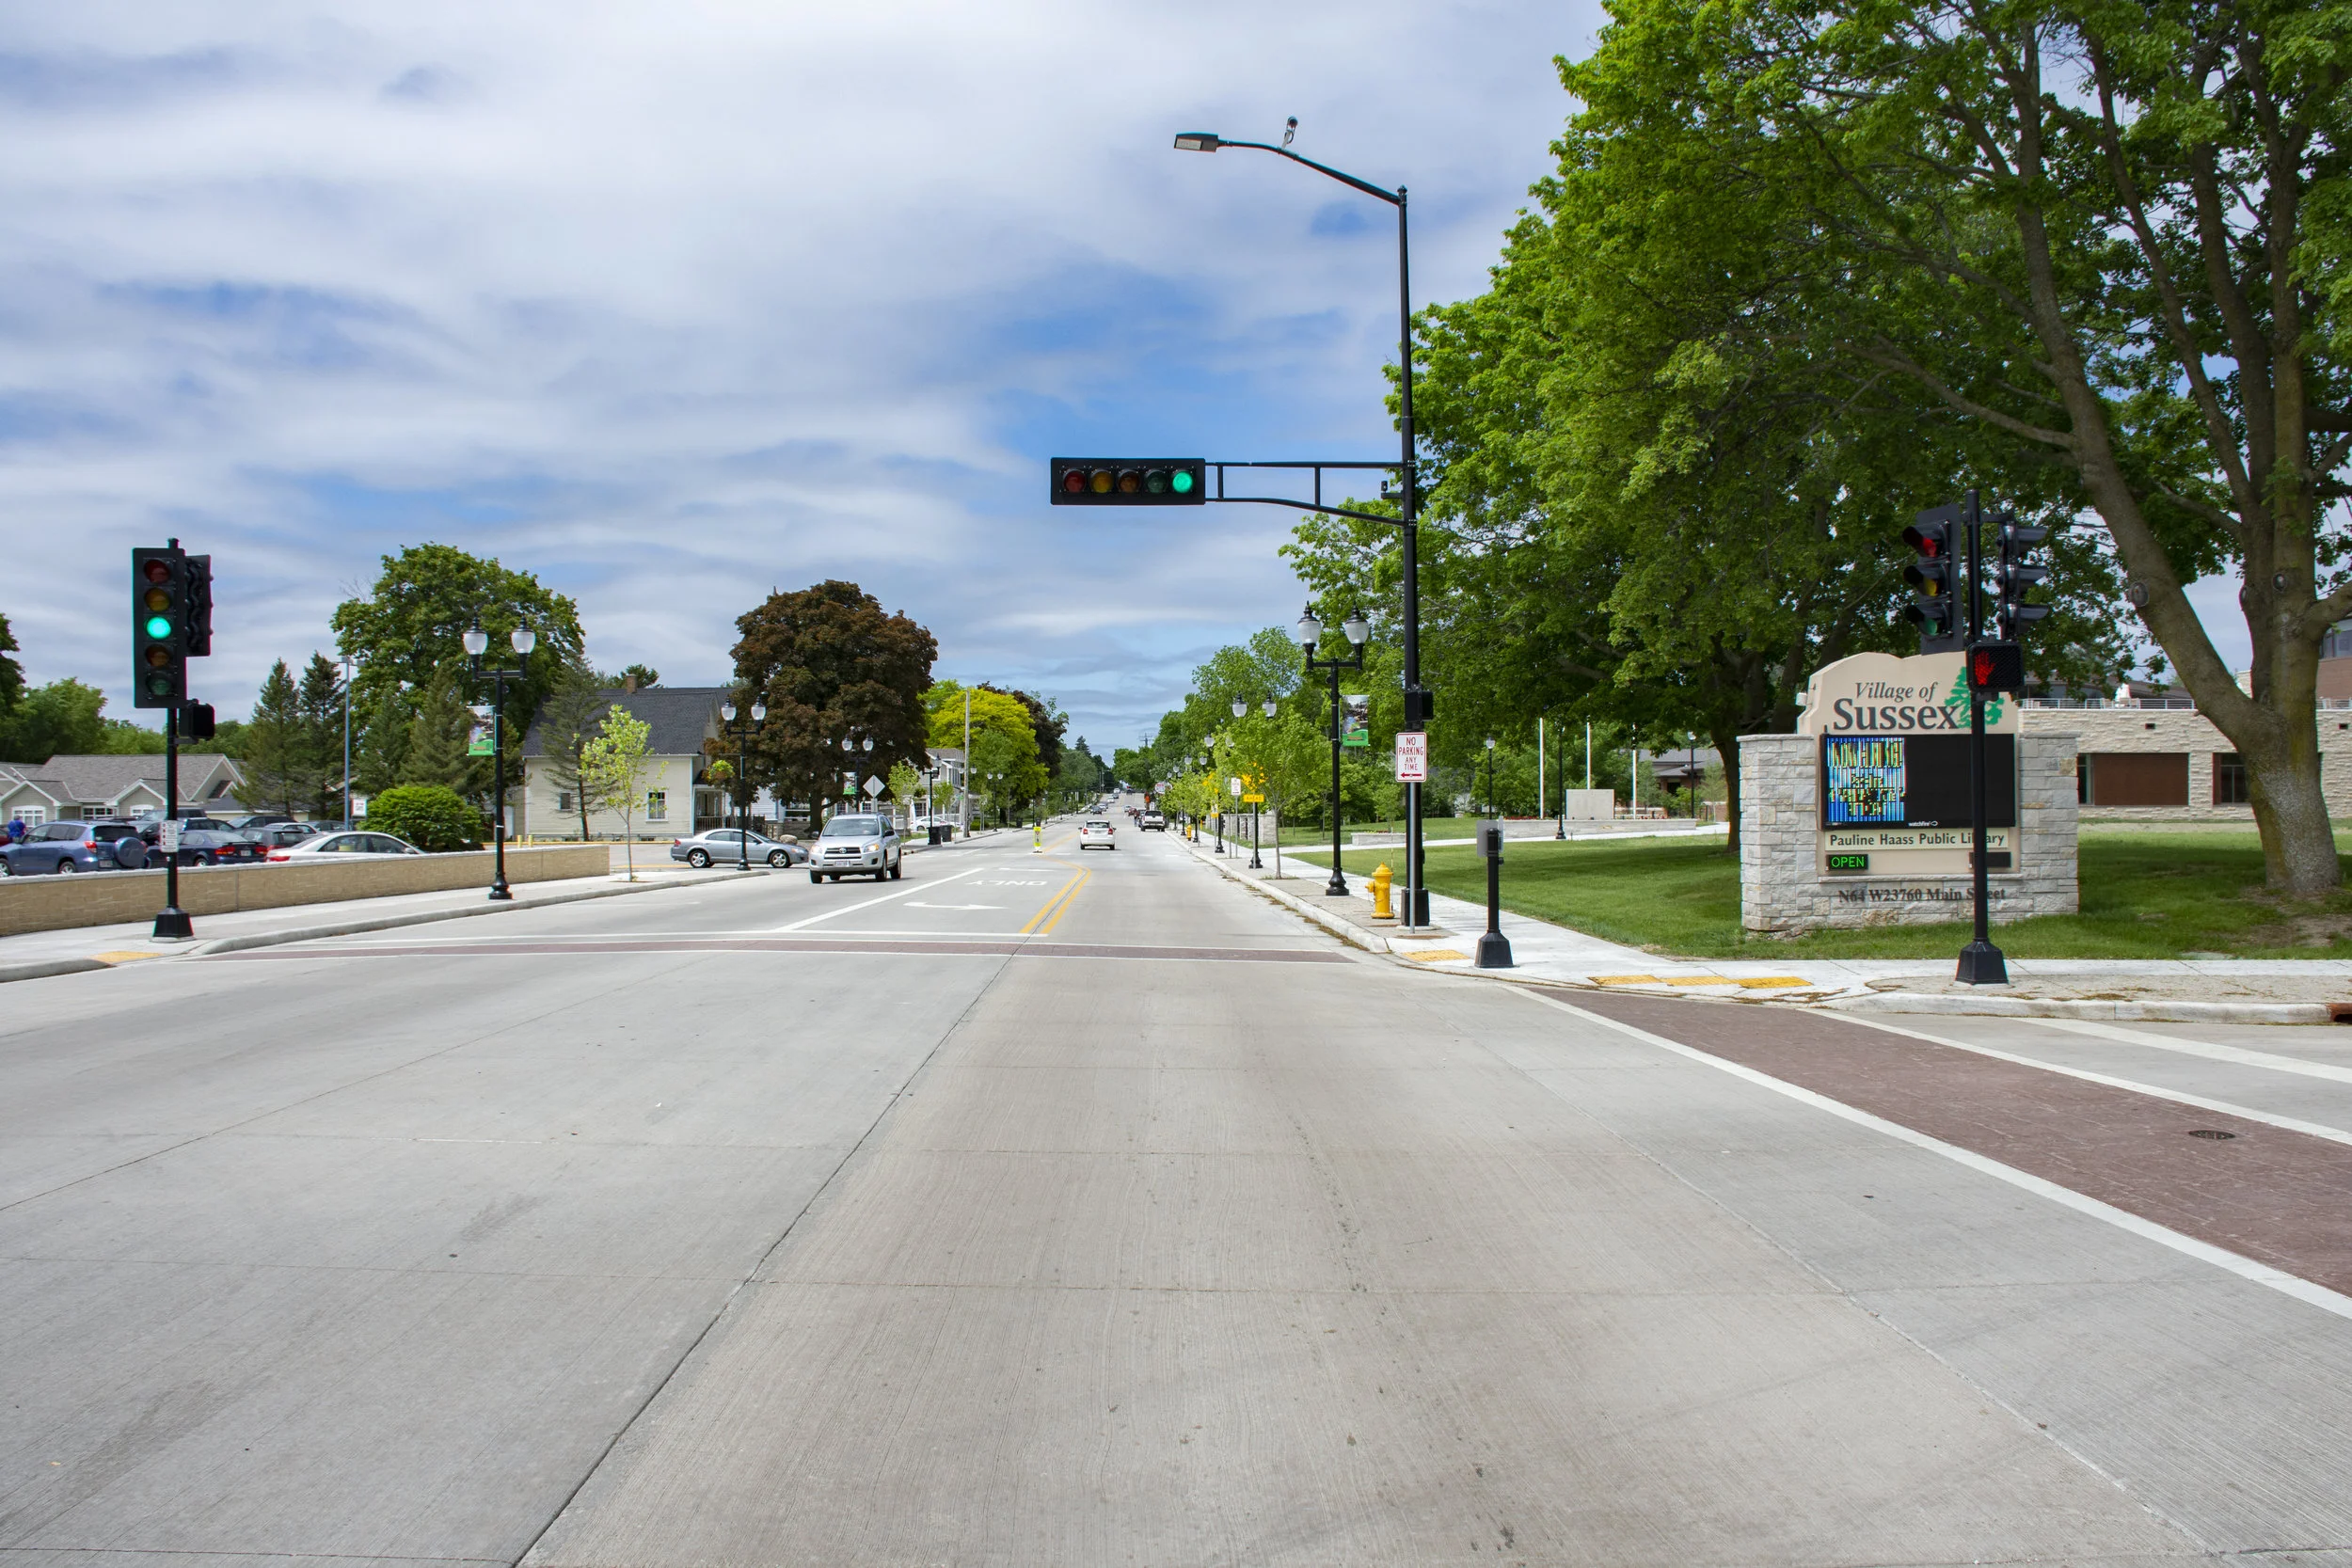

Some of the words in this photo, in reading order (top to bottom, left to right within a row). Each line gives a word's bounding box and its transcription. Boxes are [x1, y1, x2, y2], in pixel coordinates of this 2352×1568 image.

[1855, 682, 1914, 703] Village
[1918, 681, 1938, 703] of
[1833, 697, 1959, 730] Sussex
[1406, 736, 1416, 745] NO
[1399, 747, 1423, 755] PARKING
[1830, 833, 1875, 847] Pauline
[1880, 833, 1915, 846] Haass
[1919, 832, 1956, 845] Public
[1961, 832, 2004, 846] Liary
[1831, 856, 1865, 867] OPEN
[1838, 890, 1866, 903] N64
[1868, 888, 1922, 902] W23760
[1926, 887, 1963, 901] Main
[1966, 887, 2006, 900] Seet
